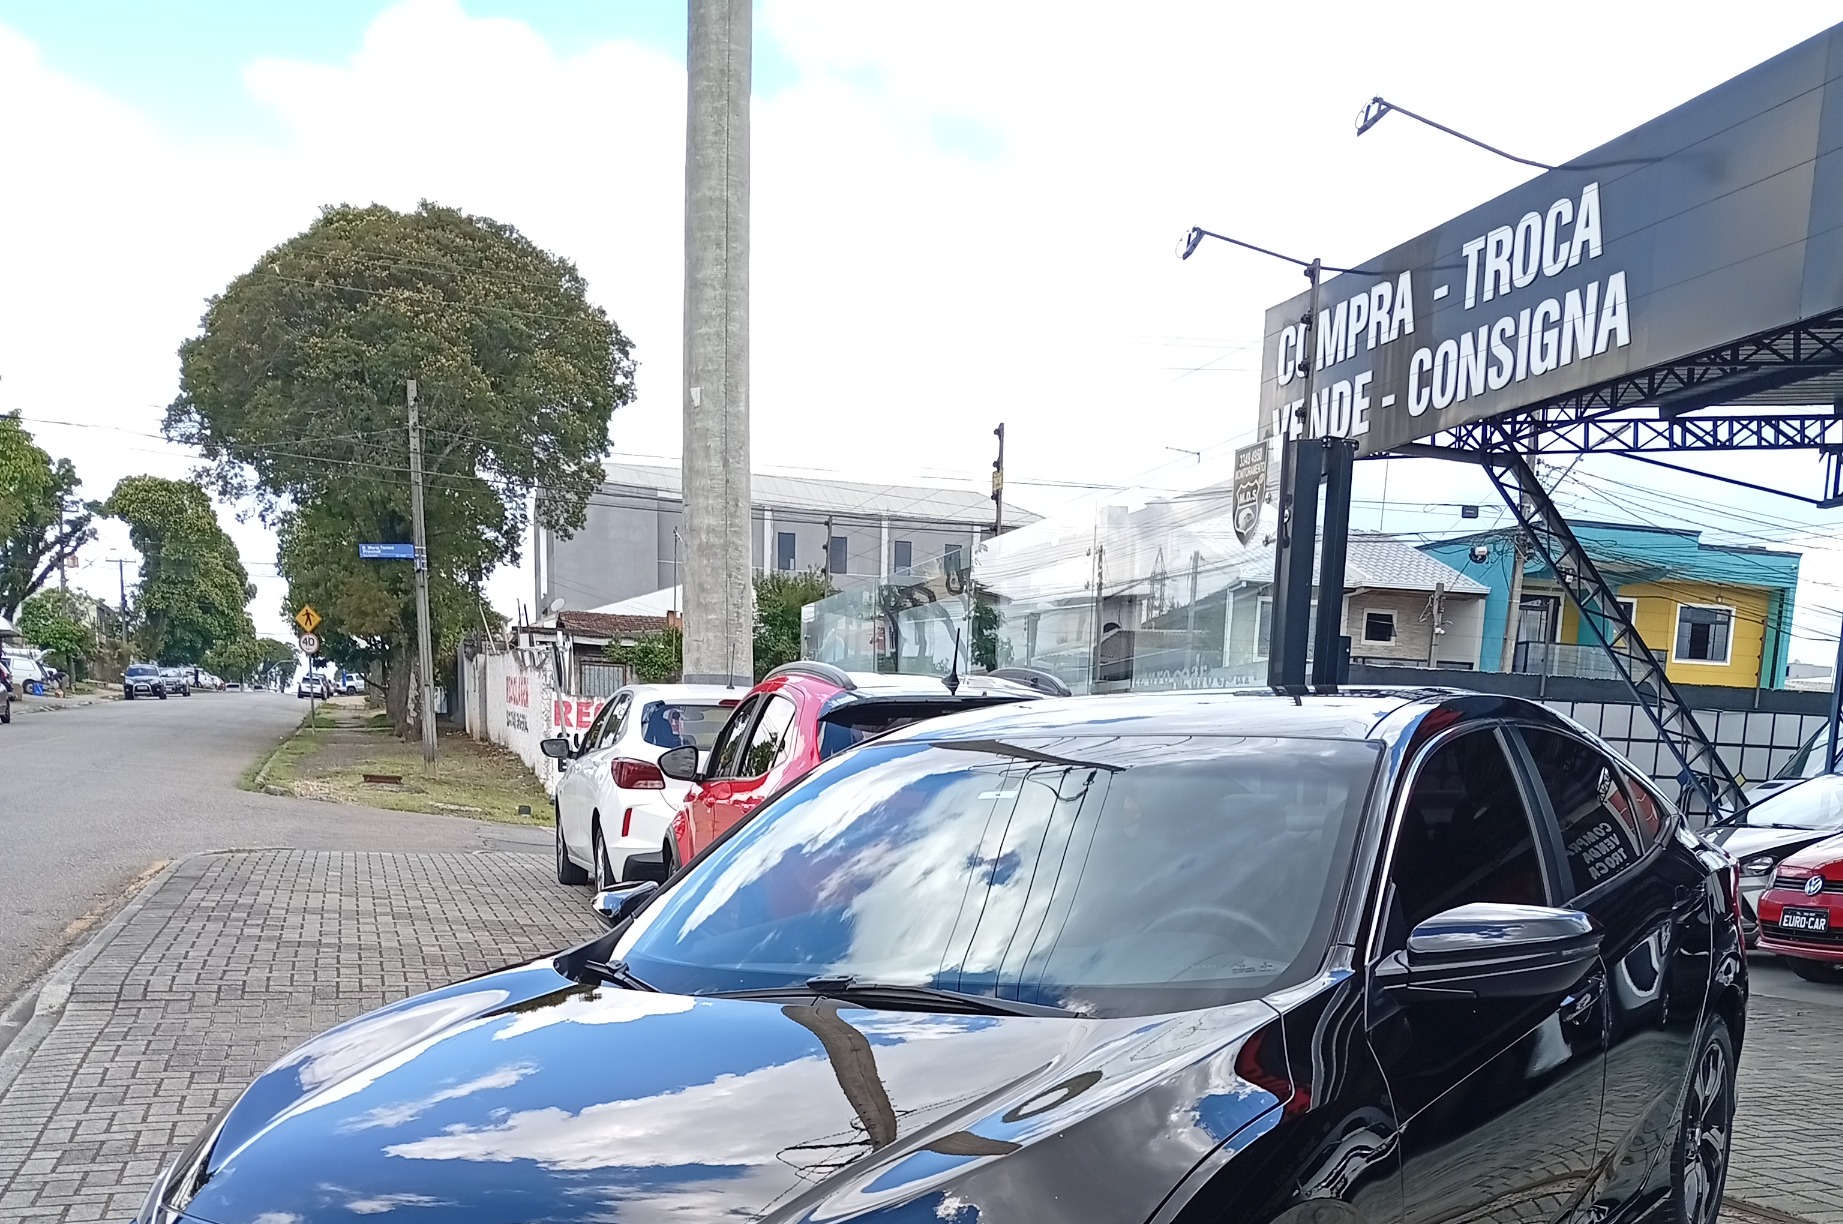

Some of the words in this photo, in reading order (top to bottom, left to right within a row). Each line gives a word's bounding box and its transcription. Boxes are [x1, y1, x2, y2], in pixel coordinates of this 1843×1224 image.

[1462, 181, 1604, 310] TROCA
[1407, 270, 1632, 417] CONSIGNA
[302, 637, 315, 647] 40
[1782, 914, 1827, 931] EURO-CAR
